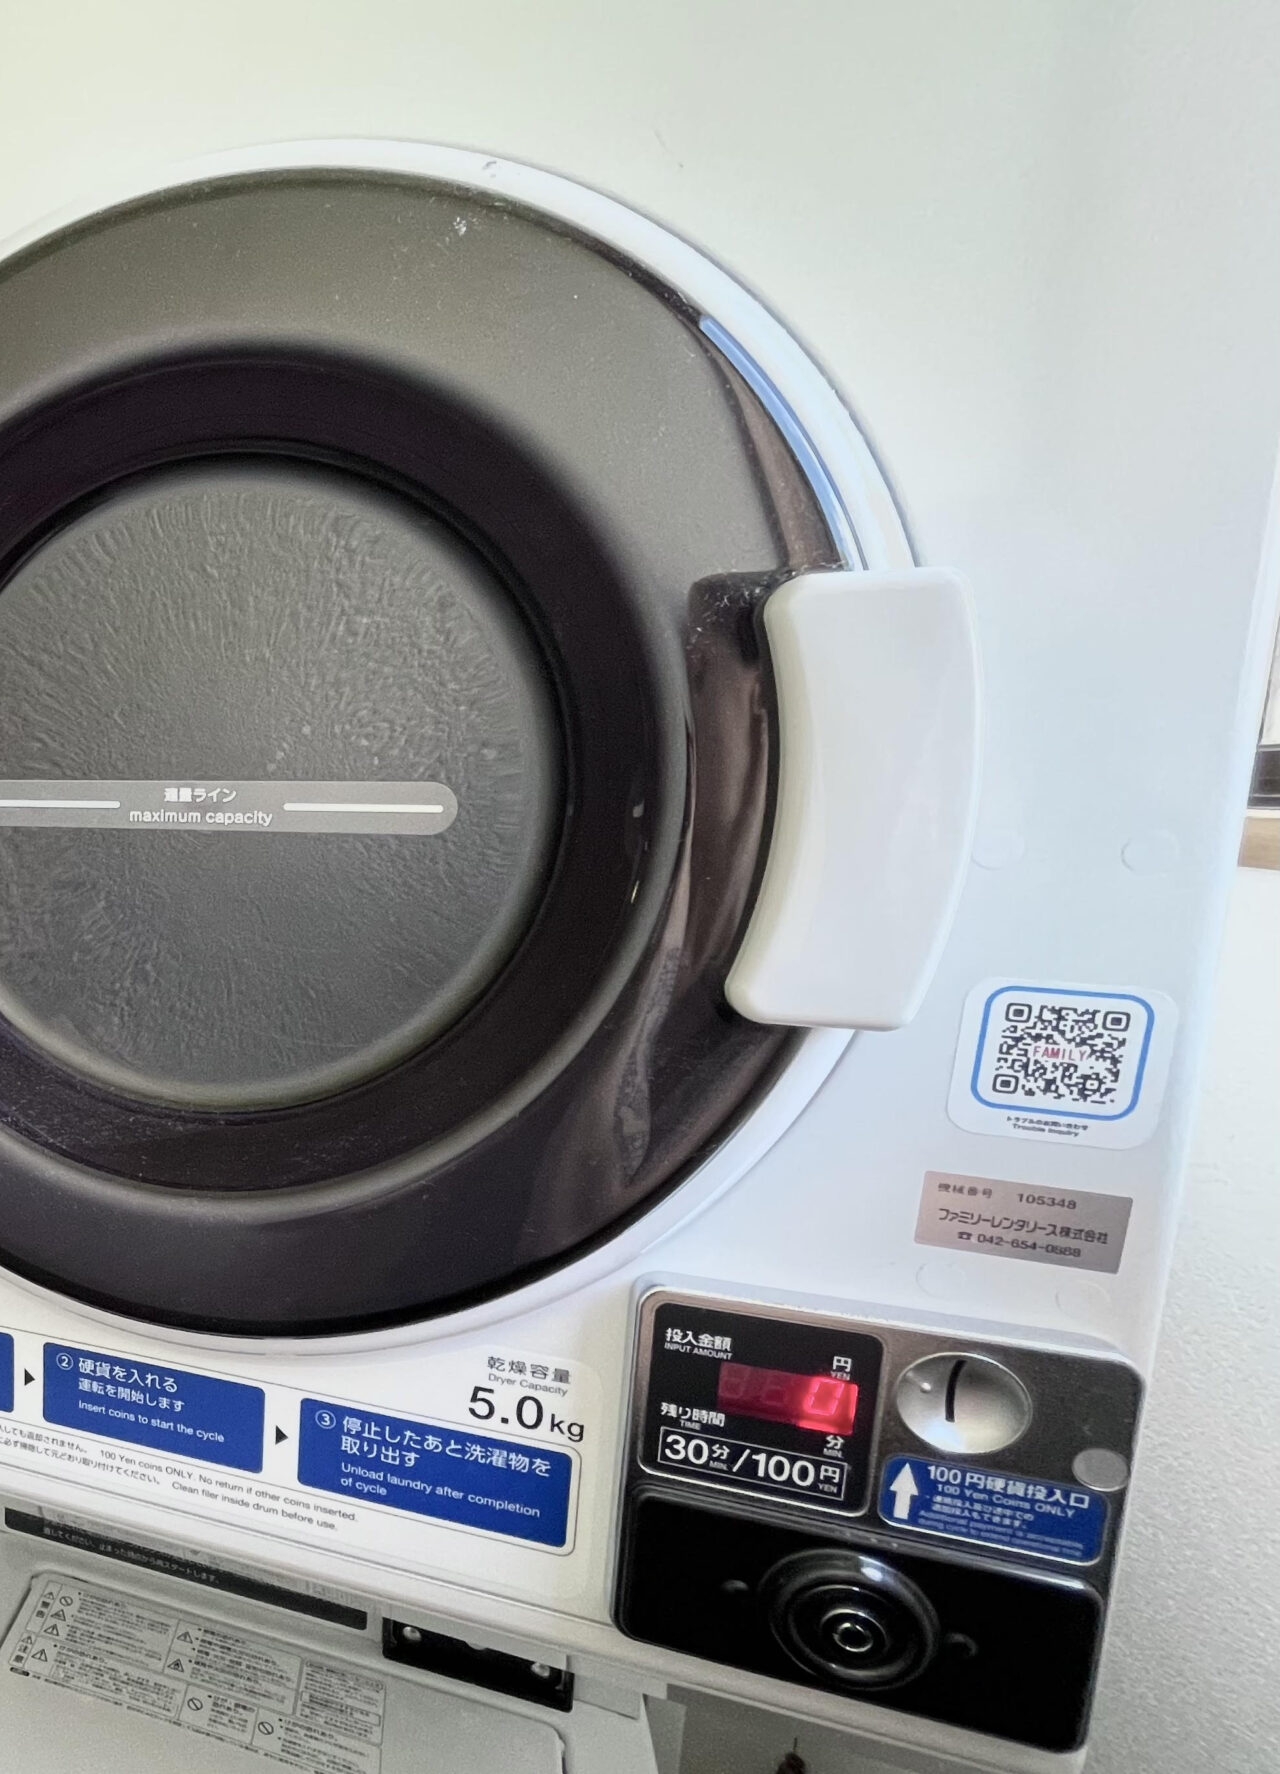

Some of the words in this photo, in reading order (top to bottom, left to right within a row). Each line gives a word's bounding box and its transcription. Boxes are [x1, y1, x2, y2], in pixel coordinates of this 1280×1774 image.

[129, 809, 201, 823] maximum
[205, 811, 272, 827] capacity
[1032, 1045, 1088, 1062] FAMILY
[937, 1182, 993, 1199] 機械番号
[1017, 1193, 1077, 1210] 105348
[938, 1207, 1108, 1245] ファミリーレンタリース株式会社
[664, 1342, 692, 1354] INPUT
[692, 1347, 733, 1361] AMOUNT
[665, 1327, 732, 1352] 投入金額
[78, 1357, 178, 1394] 硬貨を入れる
[487, 1355, 571, 1385] 乾燥容量
[830, 1371, 851, 1381] YEN
[832, 1356, 852, 1373] 円
[78, 1377, 186, 1412] 運転を開始します
[488, 1372, 517, 1389] Dryer
[519, 1378, 569, 1398] Capacity
[78, 1399, 105, 1415] Insert
[108, 1407, 136, 1423] coins
[138, 1414, 148, 1425] to
[151, 1418, 174, 1433] start
[176, 1423, 193, 1437] the
[196, 1429, 225, 1444] cycle
[661, 1402, 725, 1427] 残り時間
[680, 1419, 701, 1431] TIME
[340, 1435, 420, 1468] 取り出す
[342, 1415, 551, 1478] 停止したあと洗濯物を
[826, 1435, 845, 1450] 分
[101, 1450, 116, 1461] 100
[119, 1455, 136, 1467] Yen
[138, 1460, 163, 1474] coins
[199, 1474, 213, 1485] No
[215, 1479, 244, 1494] return
[246, 1485, 253, 1495] if
[255, 1488, 280, 1502] other
[283, 1496, 311, 1510] coins
[313, 1502, 358, 1521] inserted.
[340, 1475, 353, 1488] of
[355, 1480, 387, 1497] cycle
[341, 1462, 383, 1482] Unload
[387, 1470, 432, 1494] laundry
[435, 1482, 464, 1500] after
[467, 1492, 541, 1518] completion
[817, 1482, 838, 1494] YEN
[927, 1465, 1090, 1509] 100円硬貨投入口
[172, 1481, 199, 1496] Clean
[221, 1493, 250, 1508] inside
[252, 1502, 278, 1515] drum
[281, 1508, 314, 1525] before
[936, 1483, 961, 1496] 100
[963, 1489, 989, 1501] Yen
[992, 1492, 1031, 1510] Coins
[1034, 1502, 1077, 1518] ONLY
